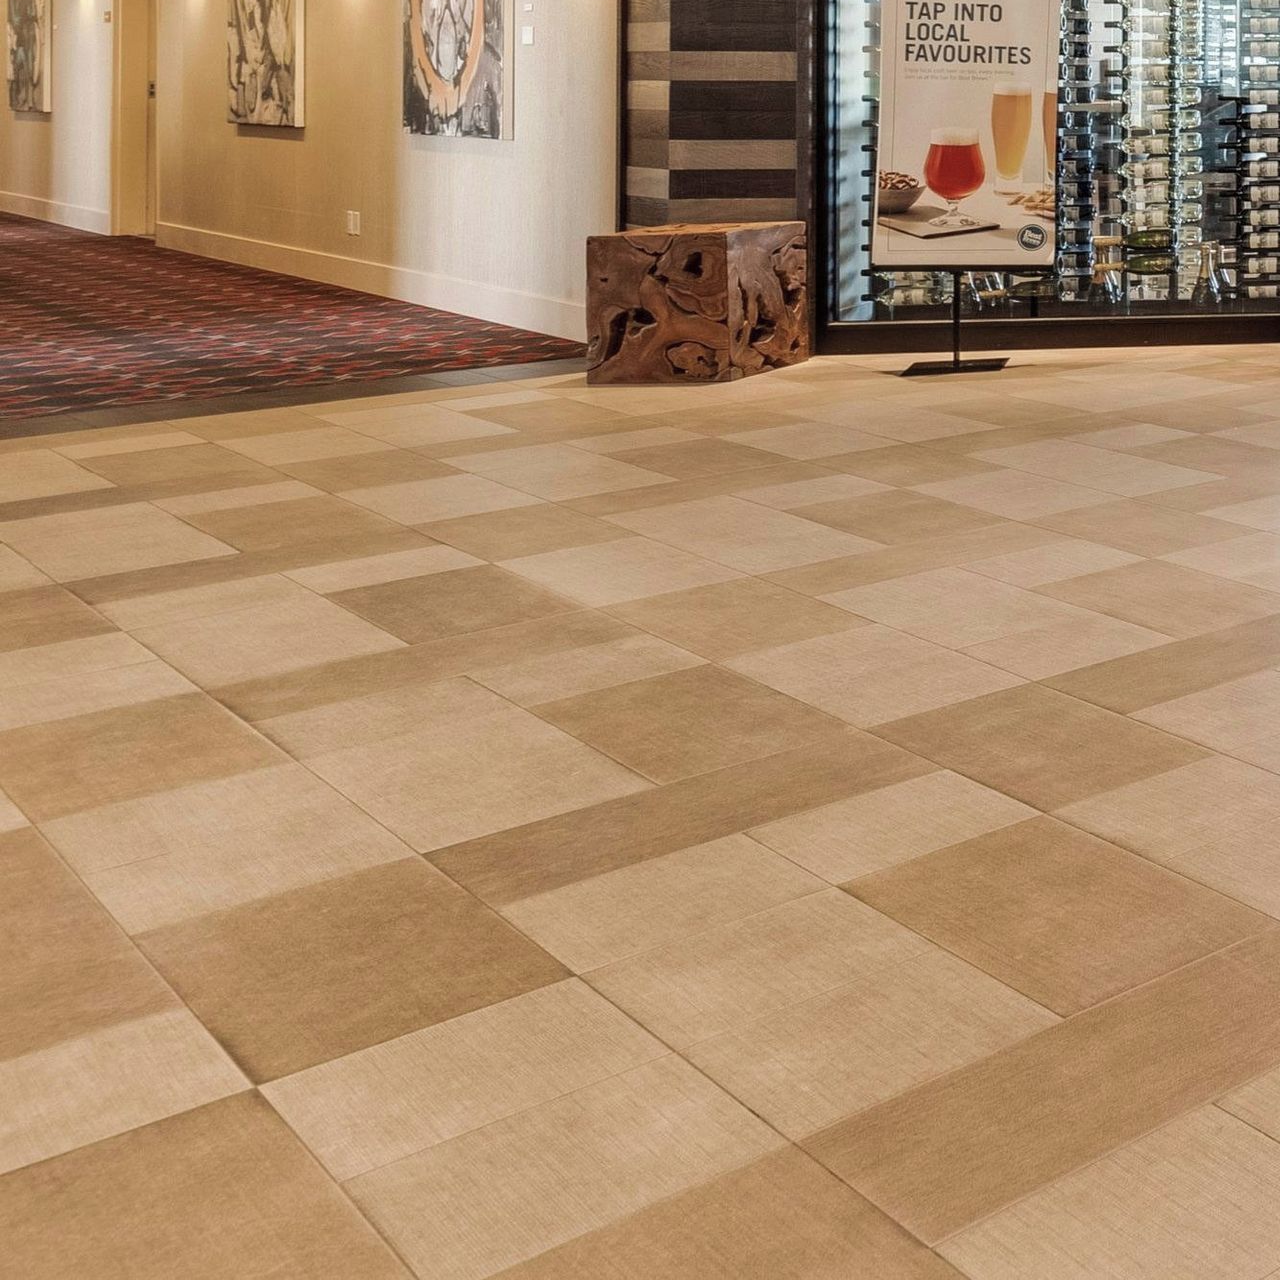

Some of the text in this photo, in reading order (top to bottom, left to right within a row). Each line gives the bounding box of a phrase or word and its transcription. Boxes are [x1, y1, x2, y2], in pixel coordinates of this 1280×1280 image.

[905, 1, 1003, 23] TAP INTO
[905, 22, 970, 42] LOCAL
[904, 43, 1032, 65] FAVOURITES
